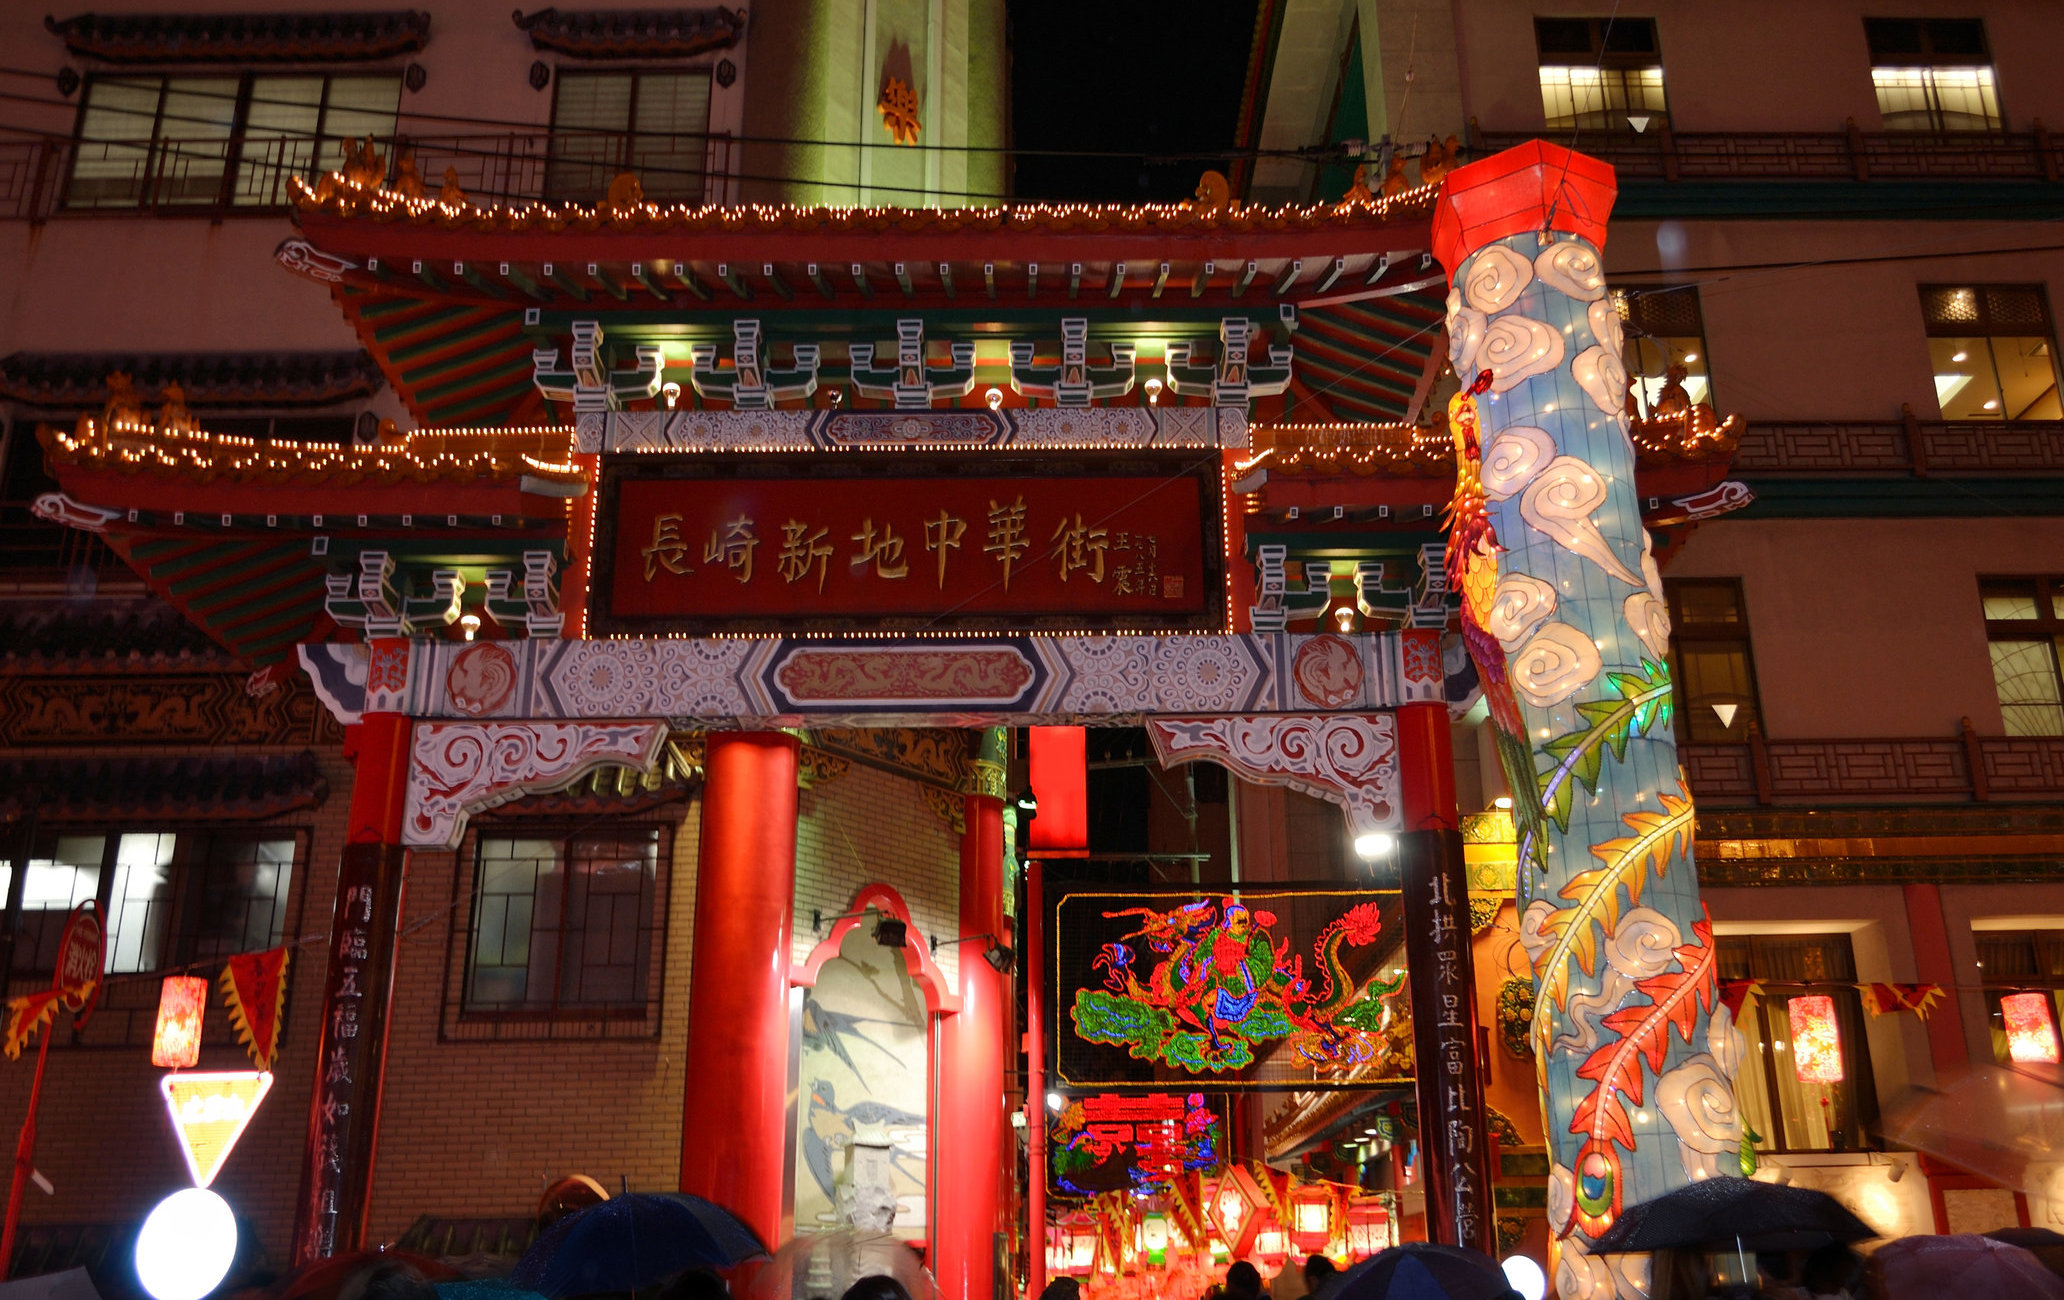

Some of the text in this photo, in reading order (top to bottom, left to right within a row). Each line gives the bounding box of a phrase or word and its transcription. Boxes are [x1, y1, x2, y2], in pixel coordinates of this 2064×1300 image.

[641, 495, 1110, 595] 長崎新地中華街
